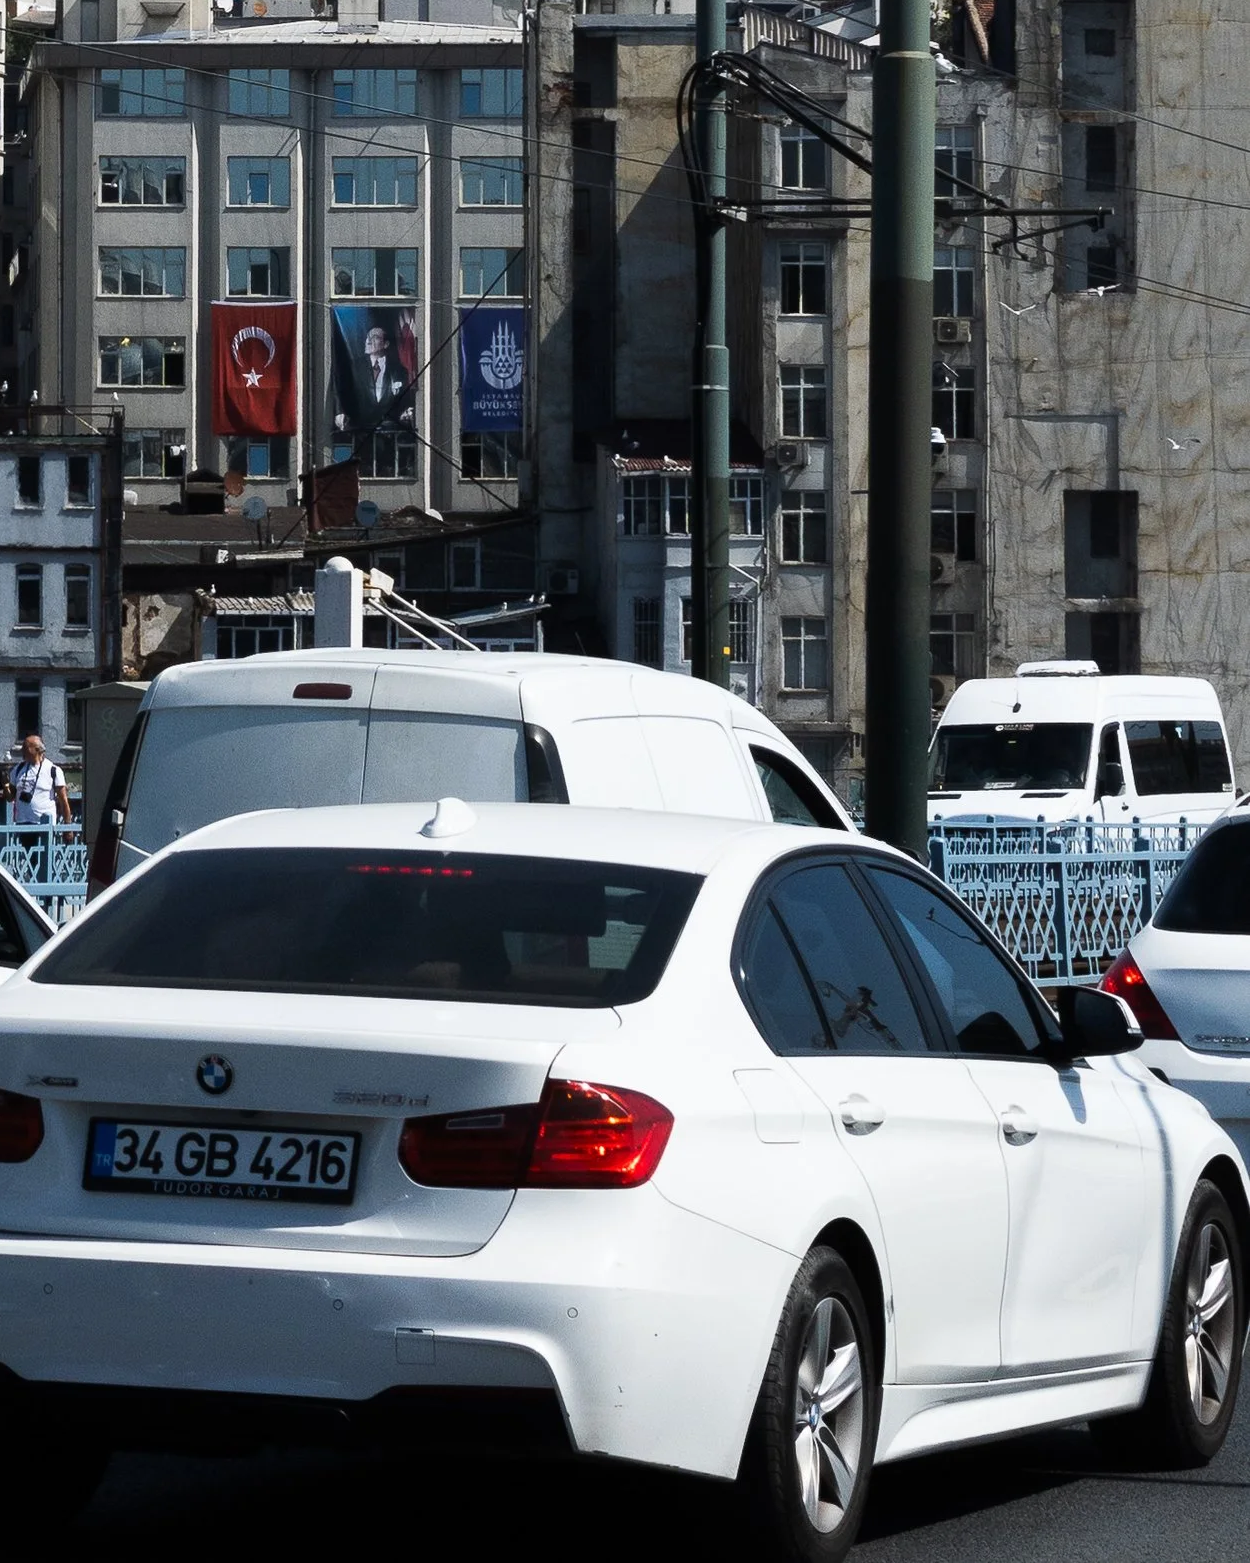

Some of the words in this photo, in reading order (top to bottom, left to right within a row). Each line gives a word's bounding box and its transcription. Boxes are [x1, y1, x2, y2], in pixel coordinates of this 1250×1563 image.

[95, 1153, 111, 1167] TR
[114, 1128, 164, 1175] 34
[174, 1131, 239, 1177] GB
[249, 1136, 348, 1185] 4216
[152, 1180, 212, 1194] TUDOR
[218, 1184, 281, 1199] GARAJ
